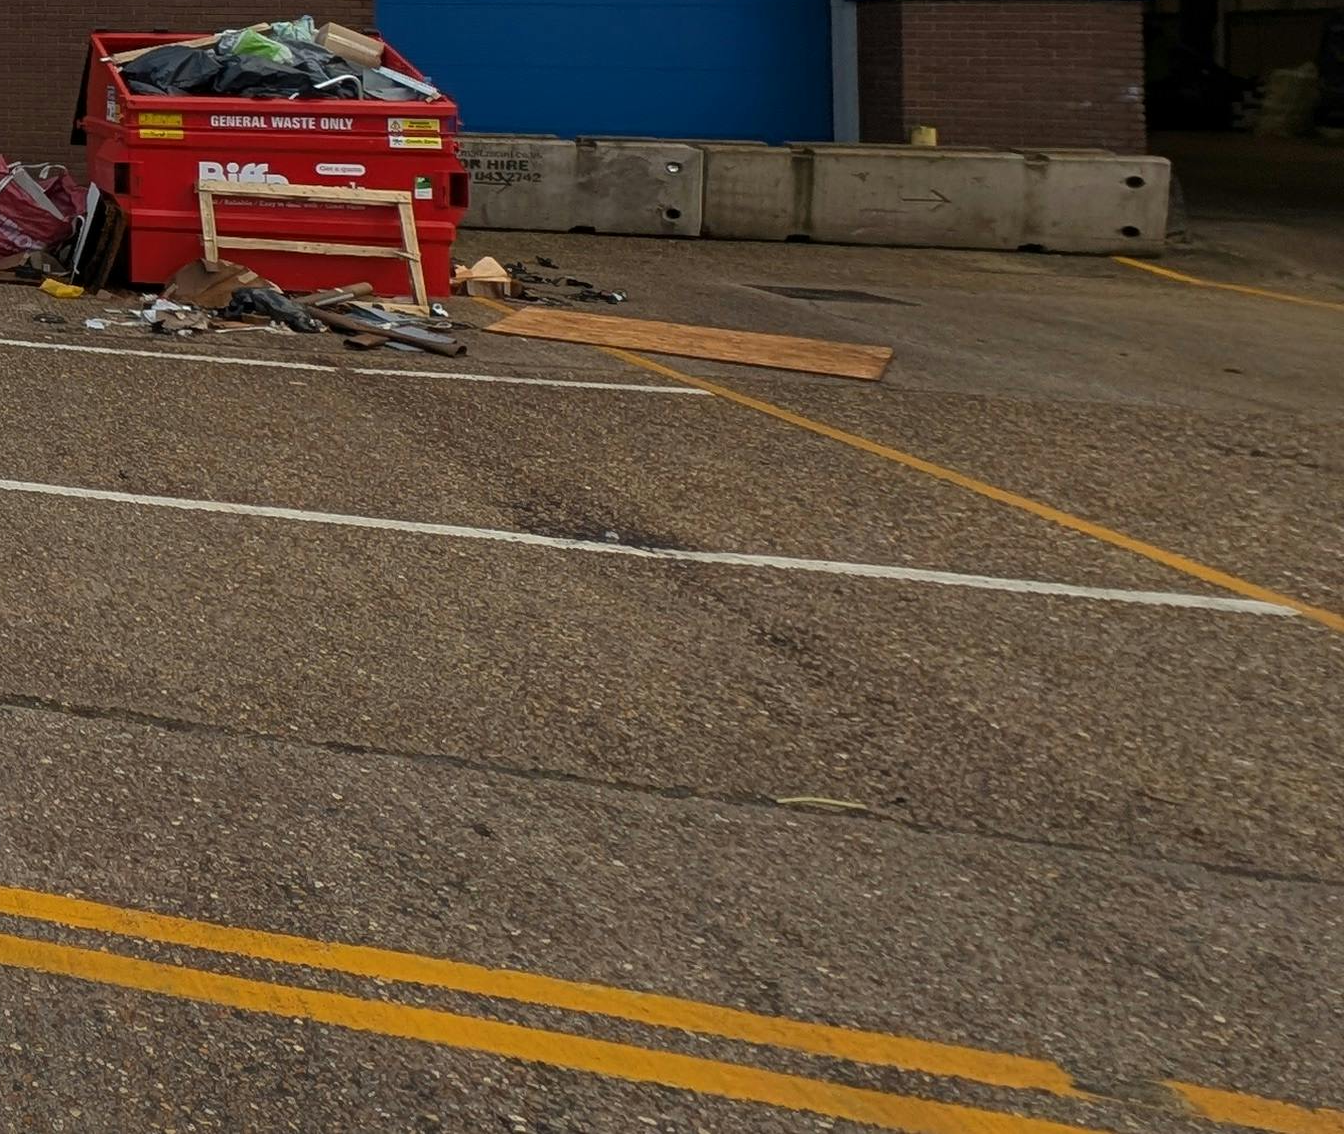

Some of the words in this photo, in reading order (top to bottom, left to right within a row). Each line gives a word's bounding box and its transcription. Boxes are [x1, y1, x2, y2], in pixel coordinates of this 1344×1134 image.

[210, 115, 267, 128] GENERAL
[271, 116, 316, 129] WASTE
[320, 117, 353, 130] ONLY
[487, 159, 529, 171] HIRE
